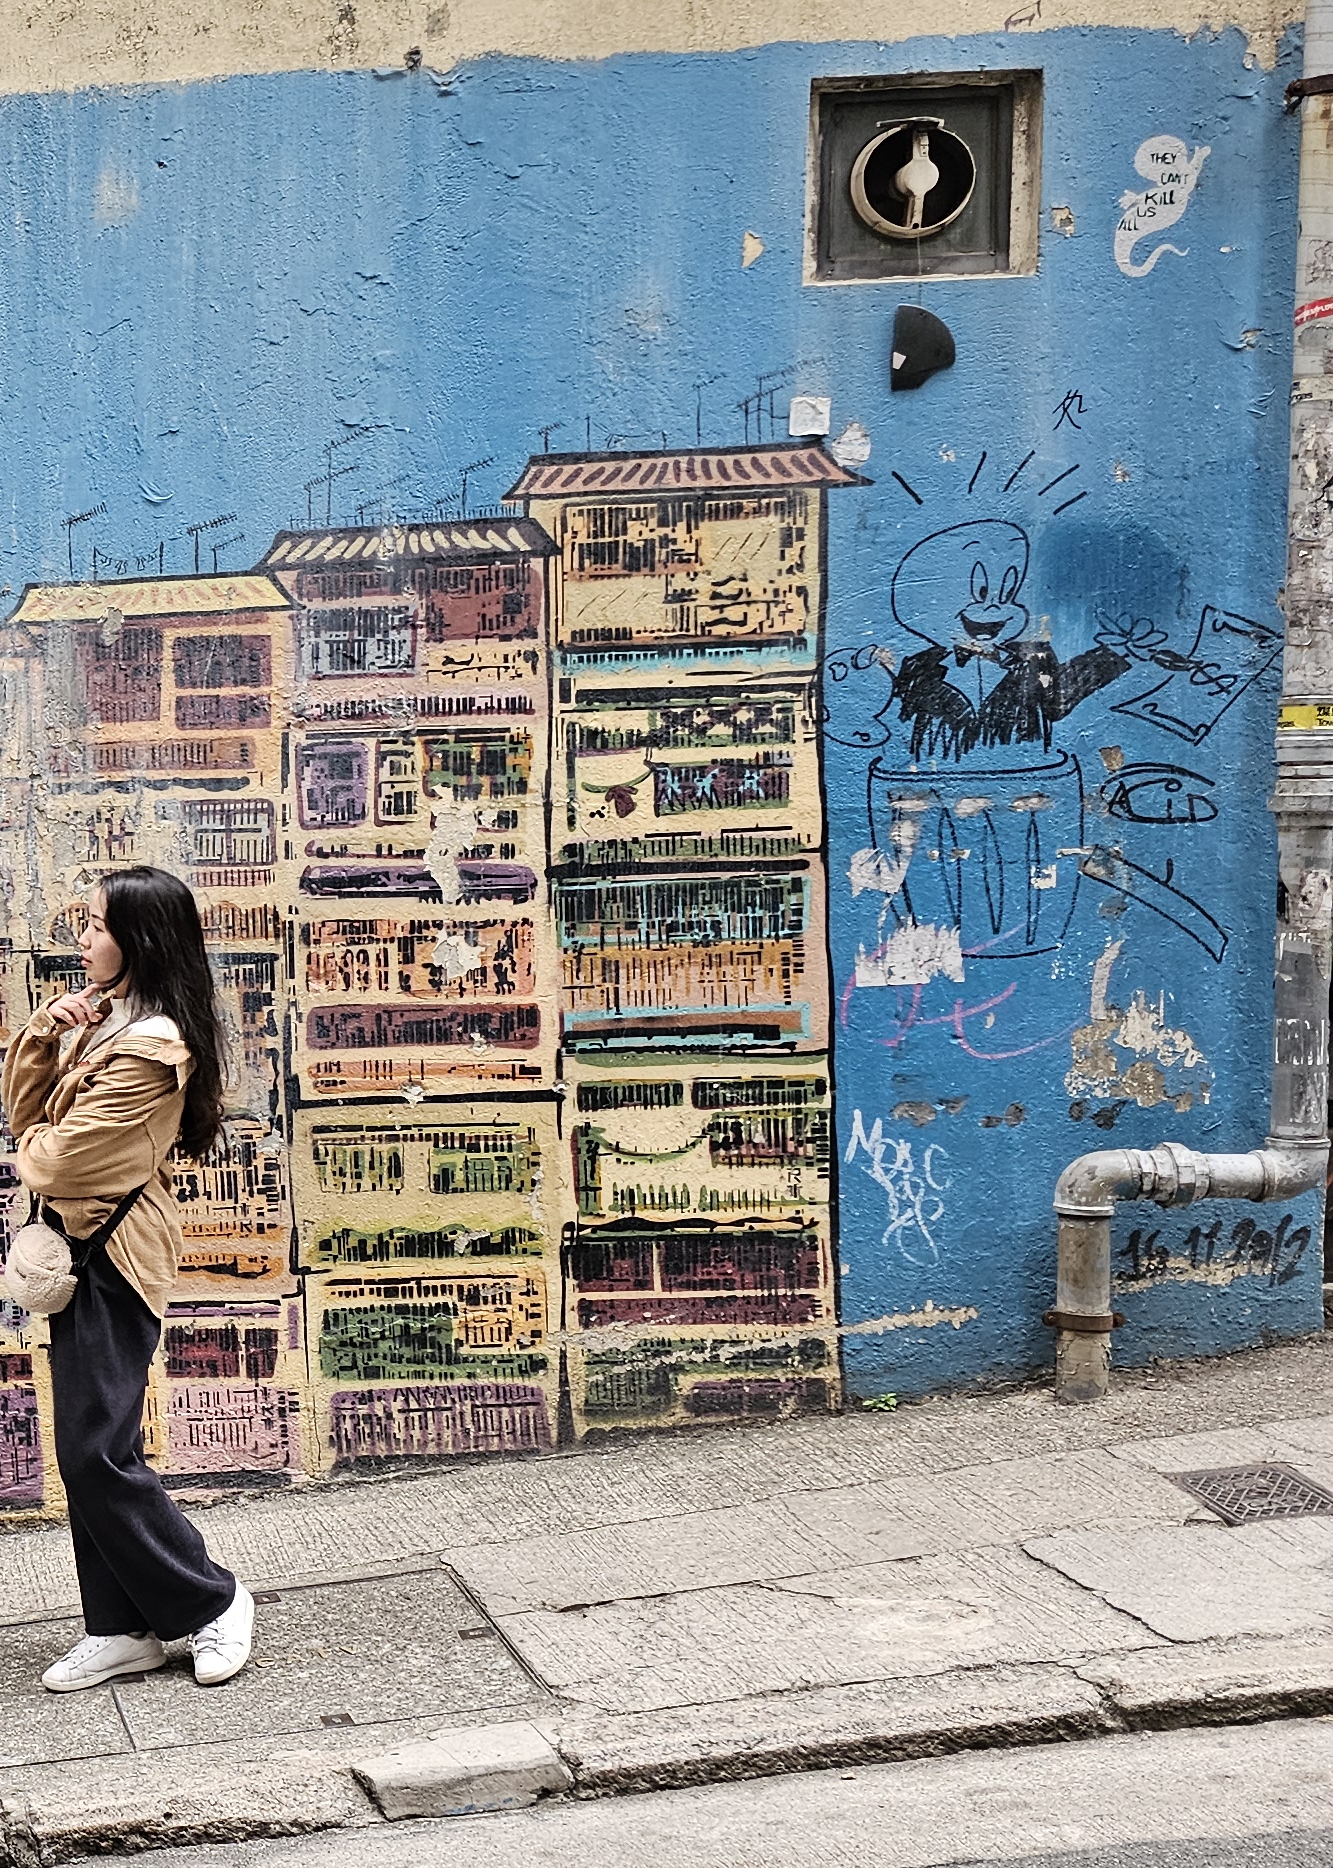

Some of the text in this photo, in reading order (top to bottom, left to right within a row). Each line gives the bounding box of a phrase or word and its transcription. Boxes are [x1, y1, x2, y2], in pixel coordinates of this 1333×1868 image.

[1150, 152, 1177, 165] THEY
[1136, 206, 1157, 218] US
[1118, 216, 1140, 231] ALL
